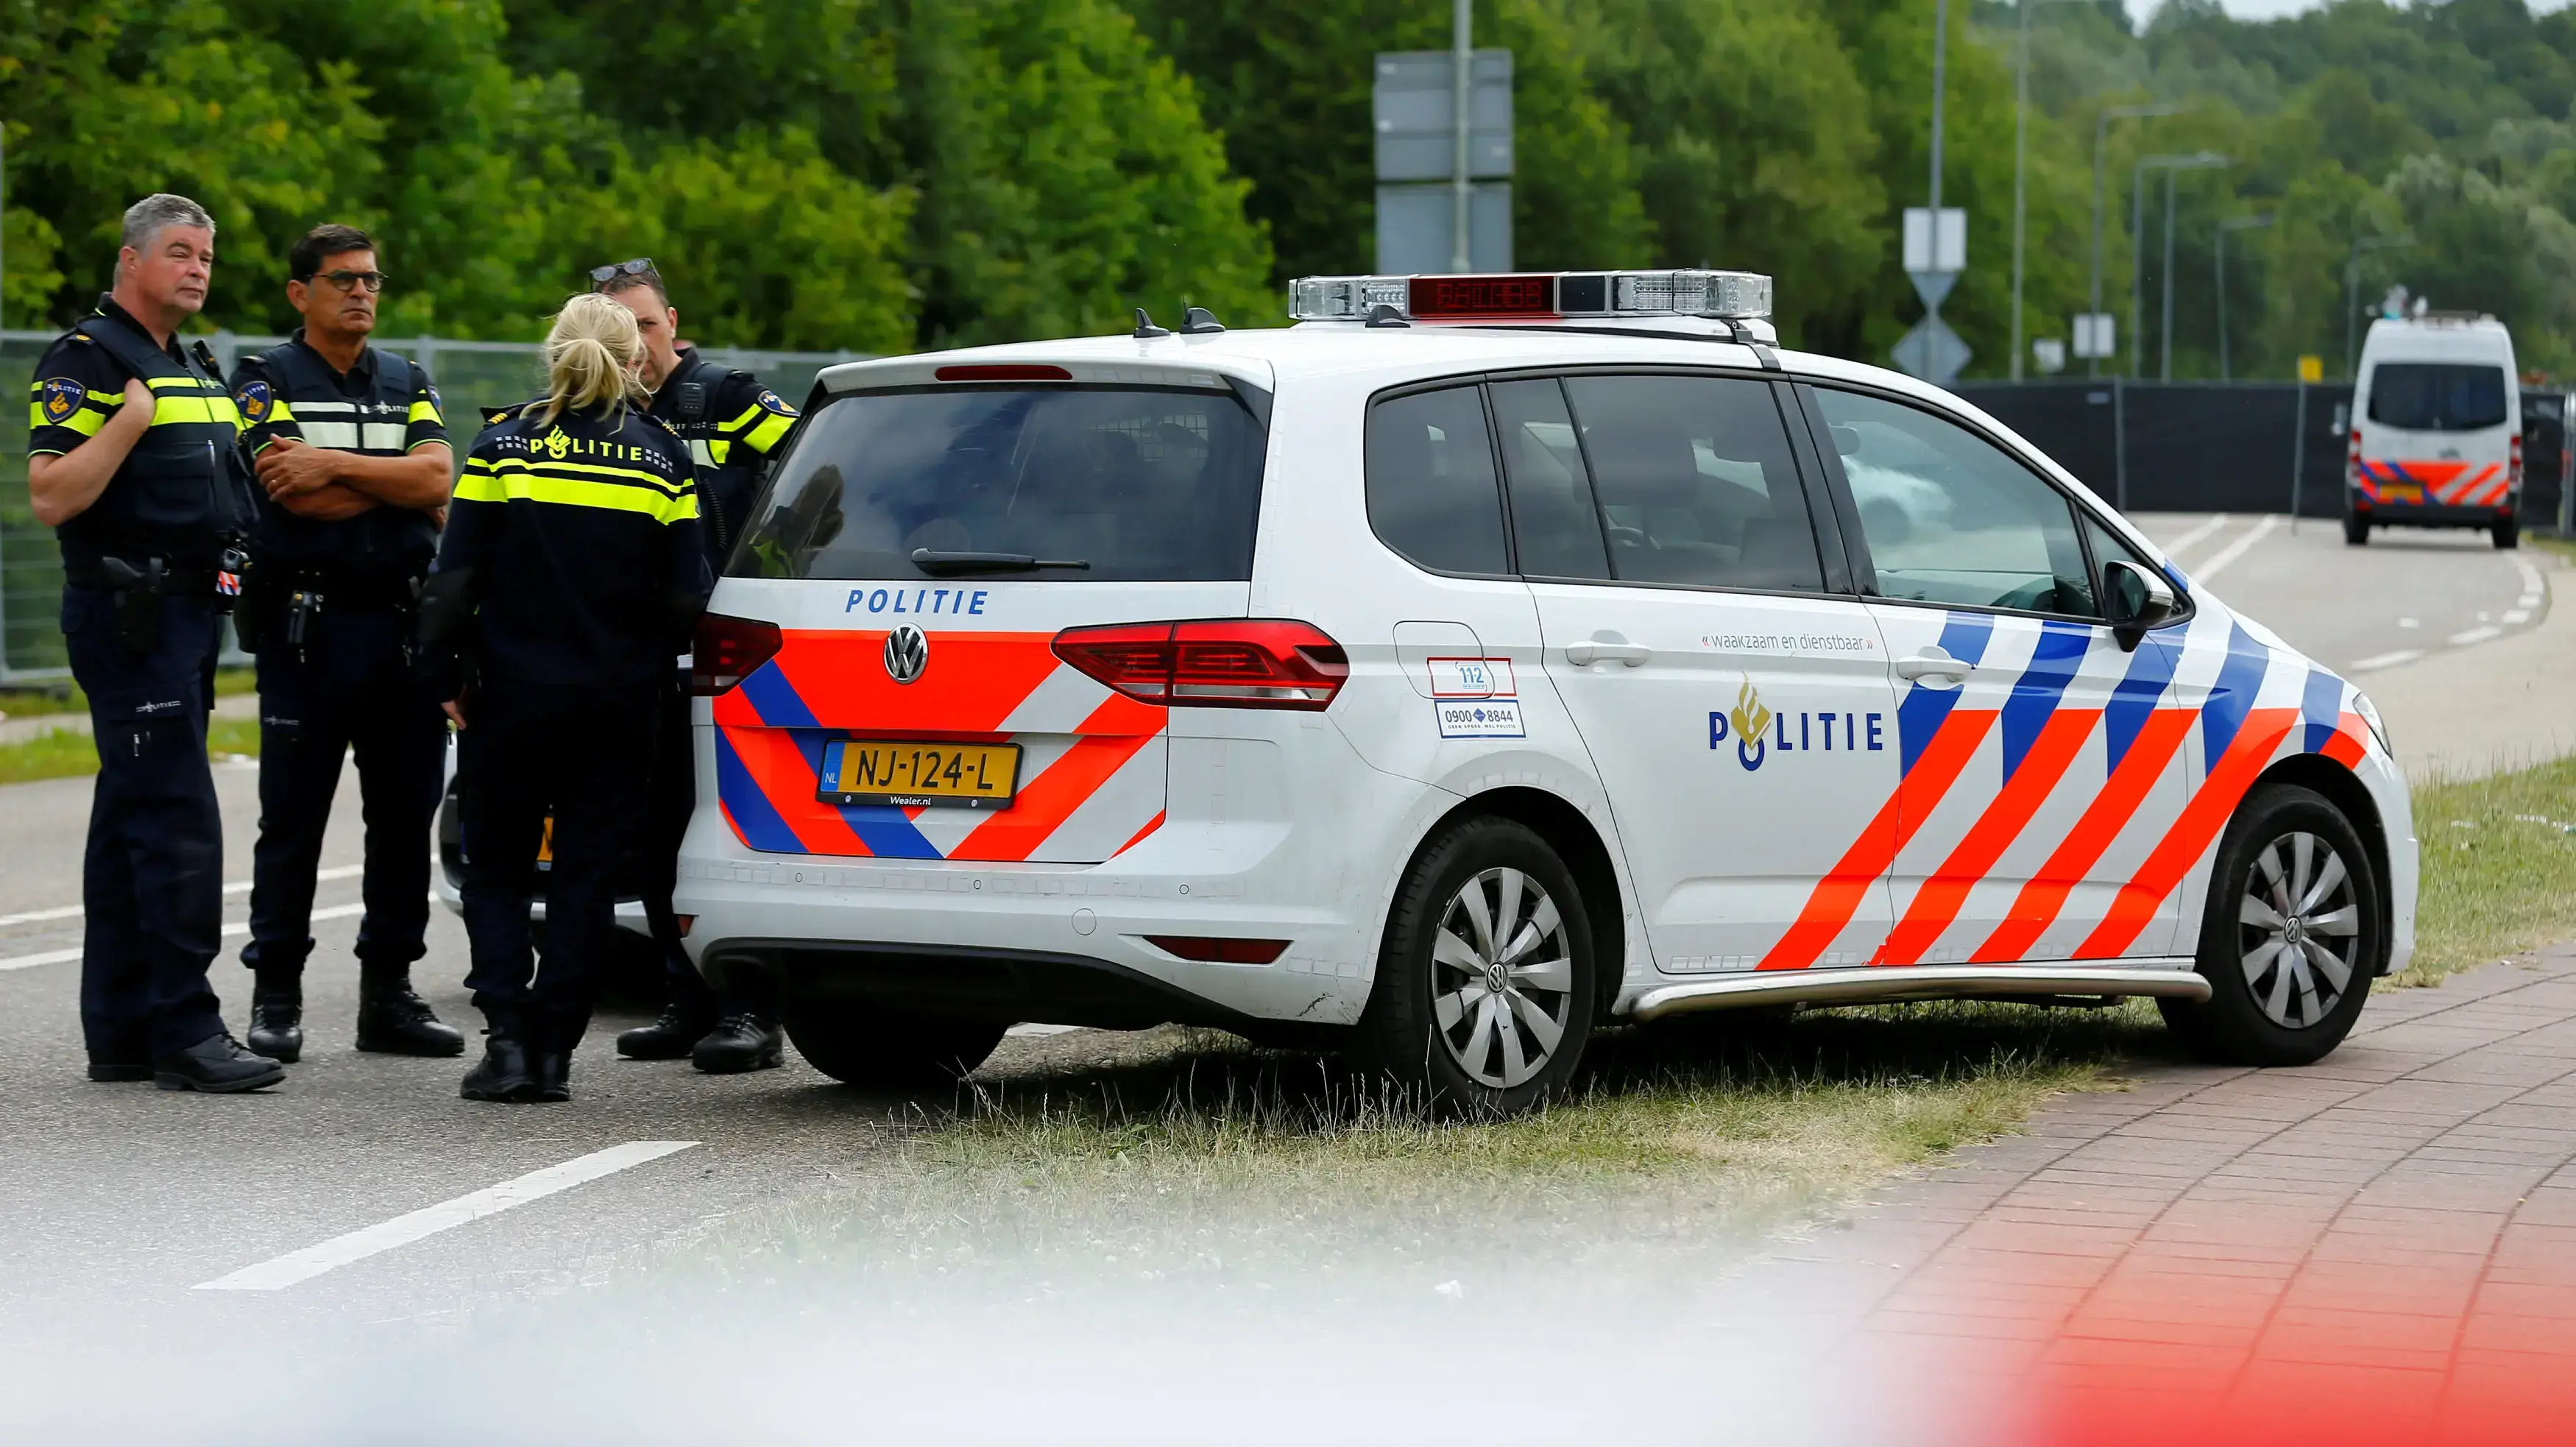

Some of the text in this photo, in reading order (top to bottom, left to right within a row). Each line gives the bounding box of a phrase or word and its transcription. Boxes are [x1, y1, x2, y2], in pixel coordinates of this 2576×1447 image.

[530, 438, 642, 461] POLITIE
[846, 590, 988, 614] POLITIE
[1710, 635, 1779, 648] waakzaam
[1782, 637, 1797, 649] en
[1800, 634, 1864, 650] dienstbaar
[1446, 710, 1472, 723] 0900
[1487, 710, 1513, 722] 8844
[1709, 711, 1883, 771] POLITIE
[825, 772, 837, 784] NL
[856, 749, 993, 790] NJ-124-L
[890, 796, 932, 806] Wealer.nl
